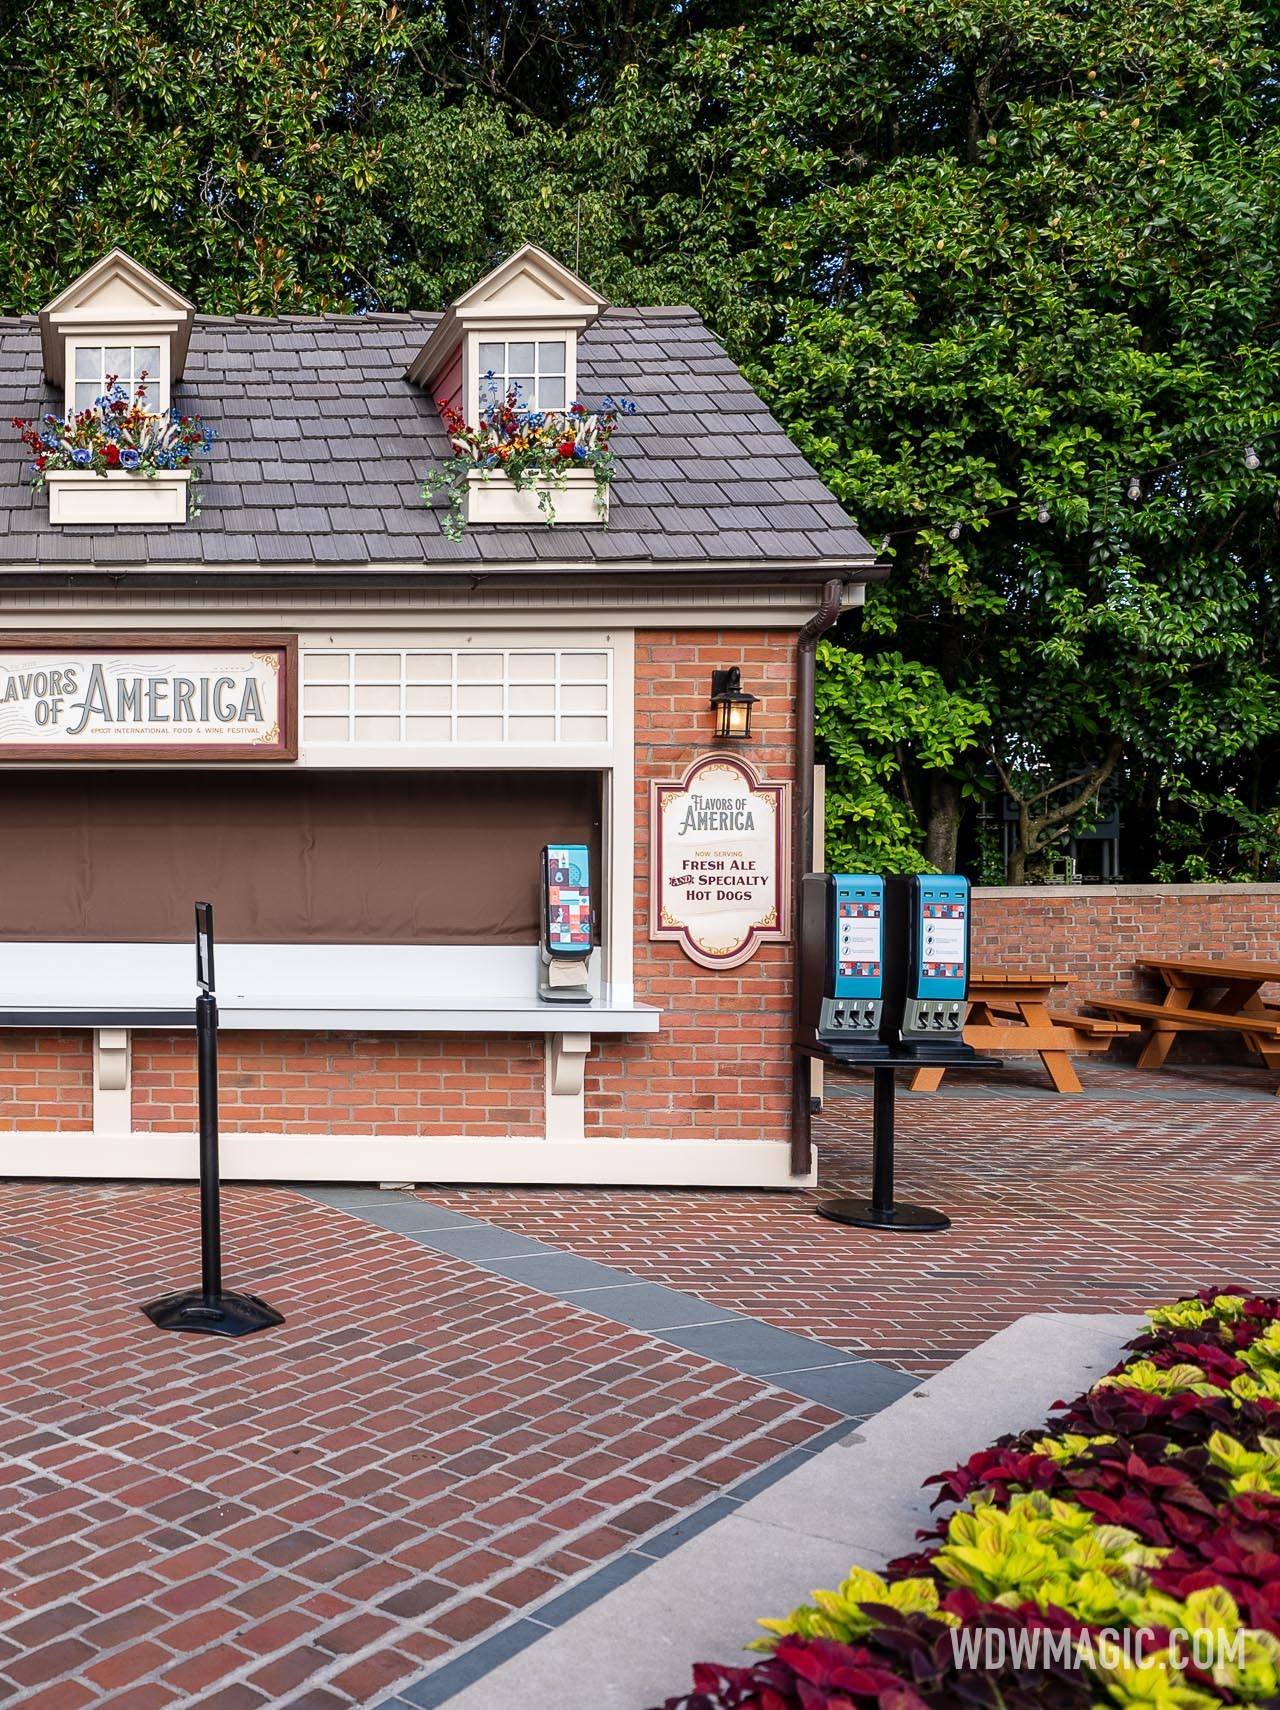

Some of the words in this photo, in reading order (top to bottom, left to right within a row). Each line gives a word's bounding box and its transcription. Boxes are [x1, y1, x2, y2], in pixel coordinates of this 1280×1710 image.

[34, 697, 65, 726] OF
[66, 663, 265, 735] AMERICA
[114, 727, 170, 735] INTERNATIONAL
[173, 727, 193, 735] FOOD
[205, 727, 224, 735] WINE
[227, 727, 260, 735] FESTIVAL
[691, 794, 733, 811] FLAVORS
[735, 798, 747, 811] OF
[678, 805, 755, 836] AMERICA
[682, 860, 724, 870] FRESH
[730, 860, 756, 870] ALE
[672, 875, 693, 886] AND
[698, 875, 768, 885] SPECIALTY
[686, 890, 712, 901] HOT
[716, 890, 752, 901] DOGS
